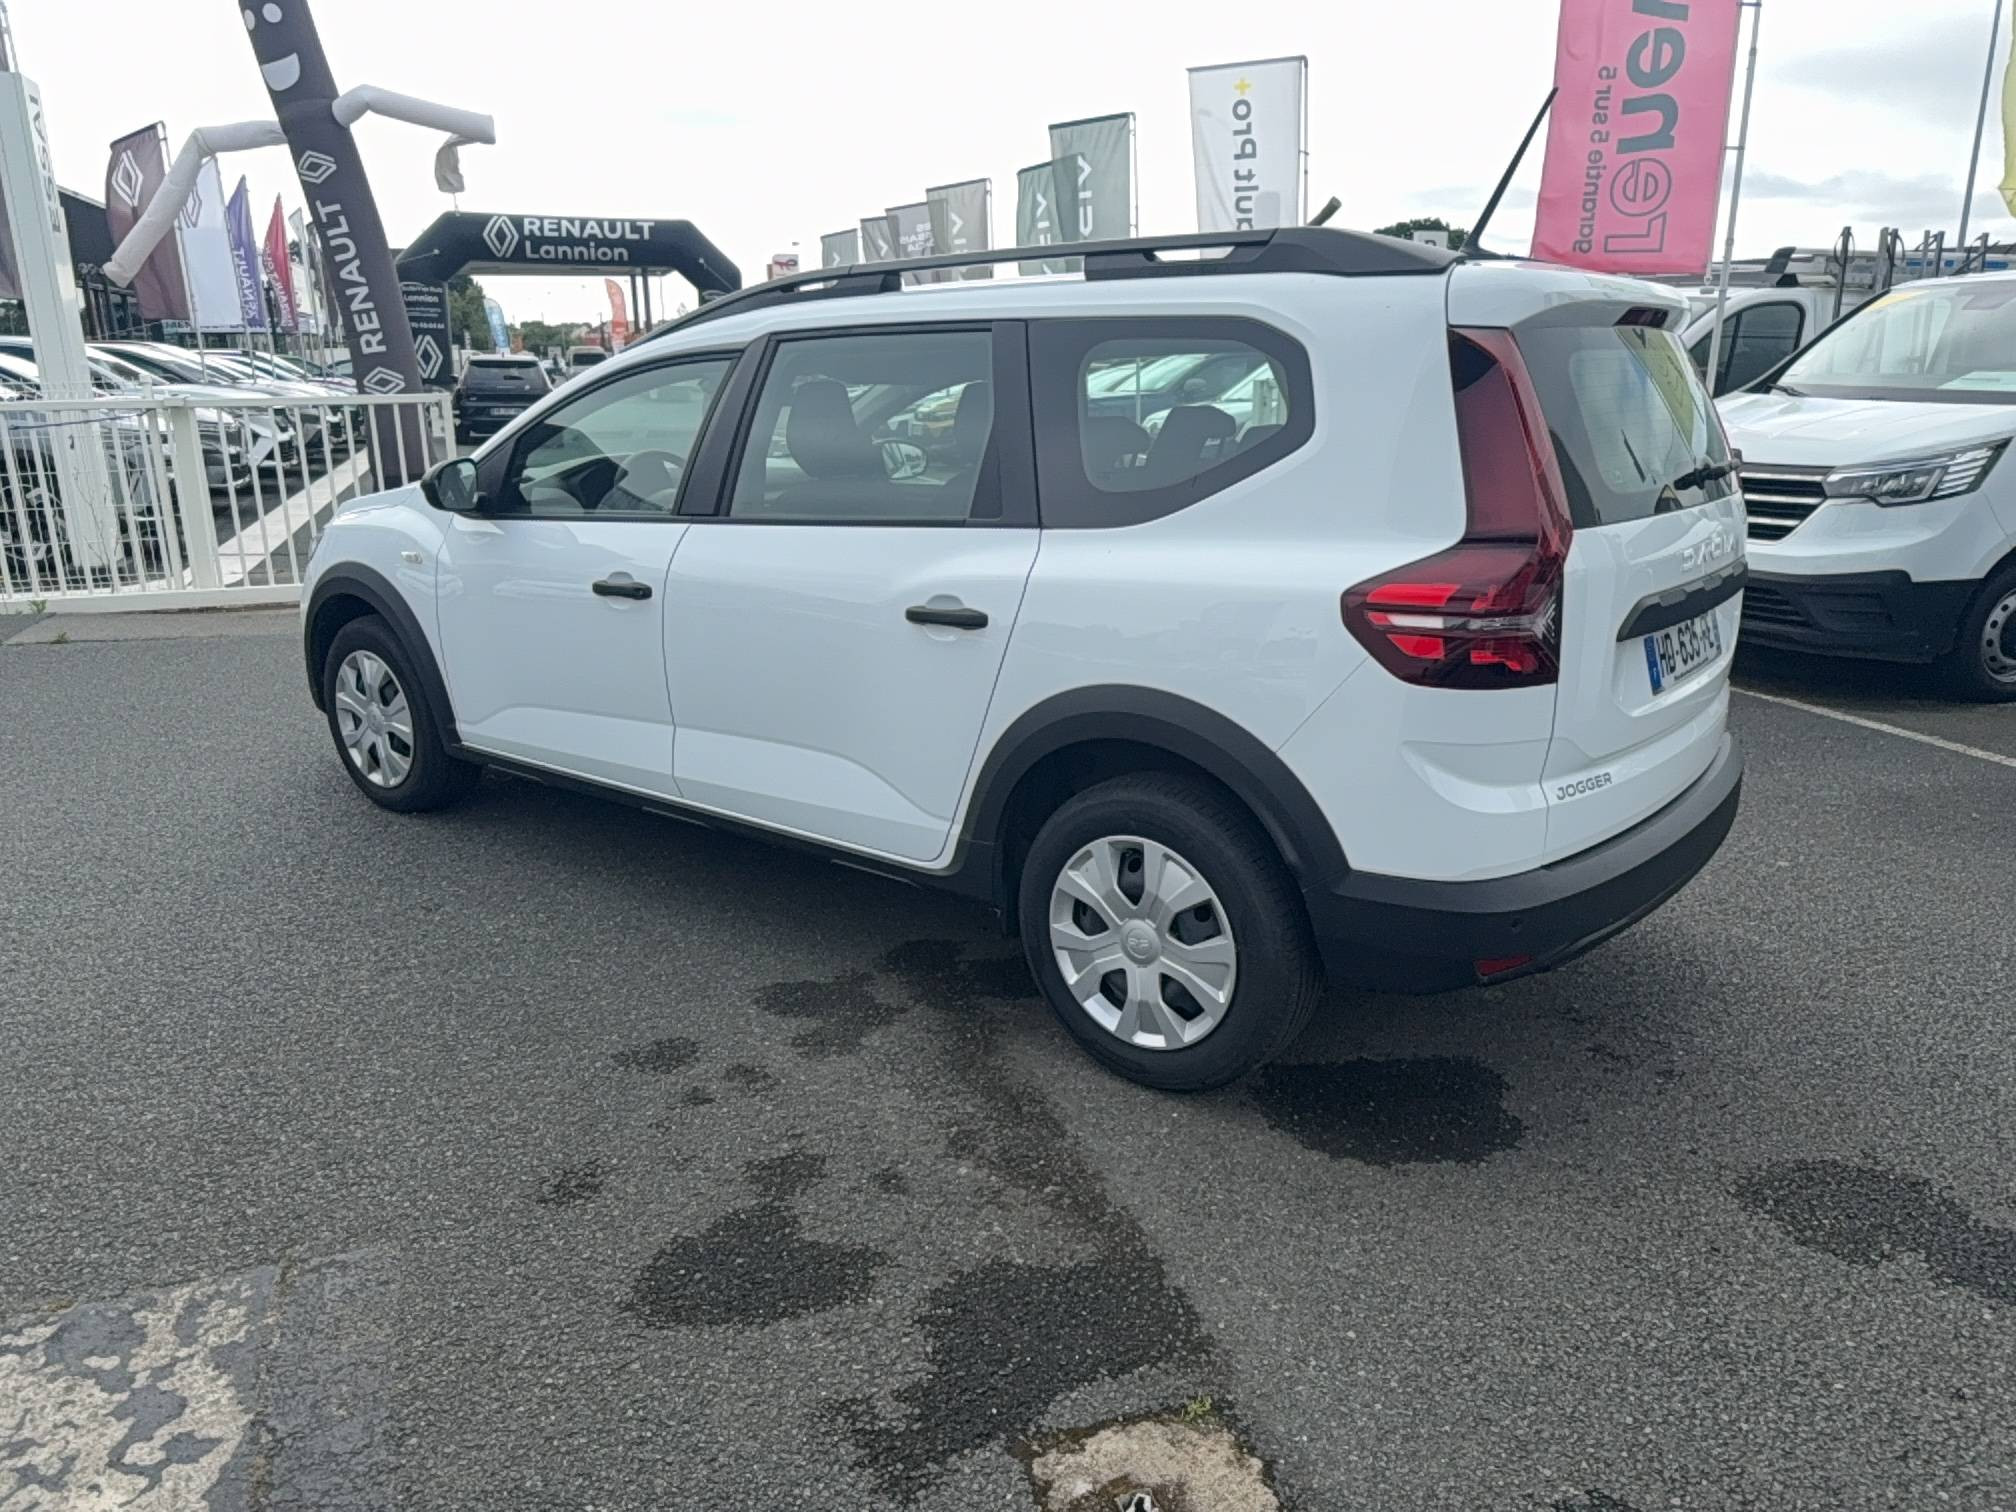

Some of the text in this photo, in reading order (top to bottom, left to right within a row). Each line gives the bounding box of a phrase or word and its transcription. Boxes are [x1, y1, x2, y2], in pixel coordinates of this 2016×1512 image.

[523, 217, 655, 241] RENAULT
[525, 240, 629, 262] Lannion
[315, 200, 387, 354] RENAULT
[1556, 772, 1613, 801] JOGGER
